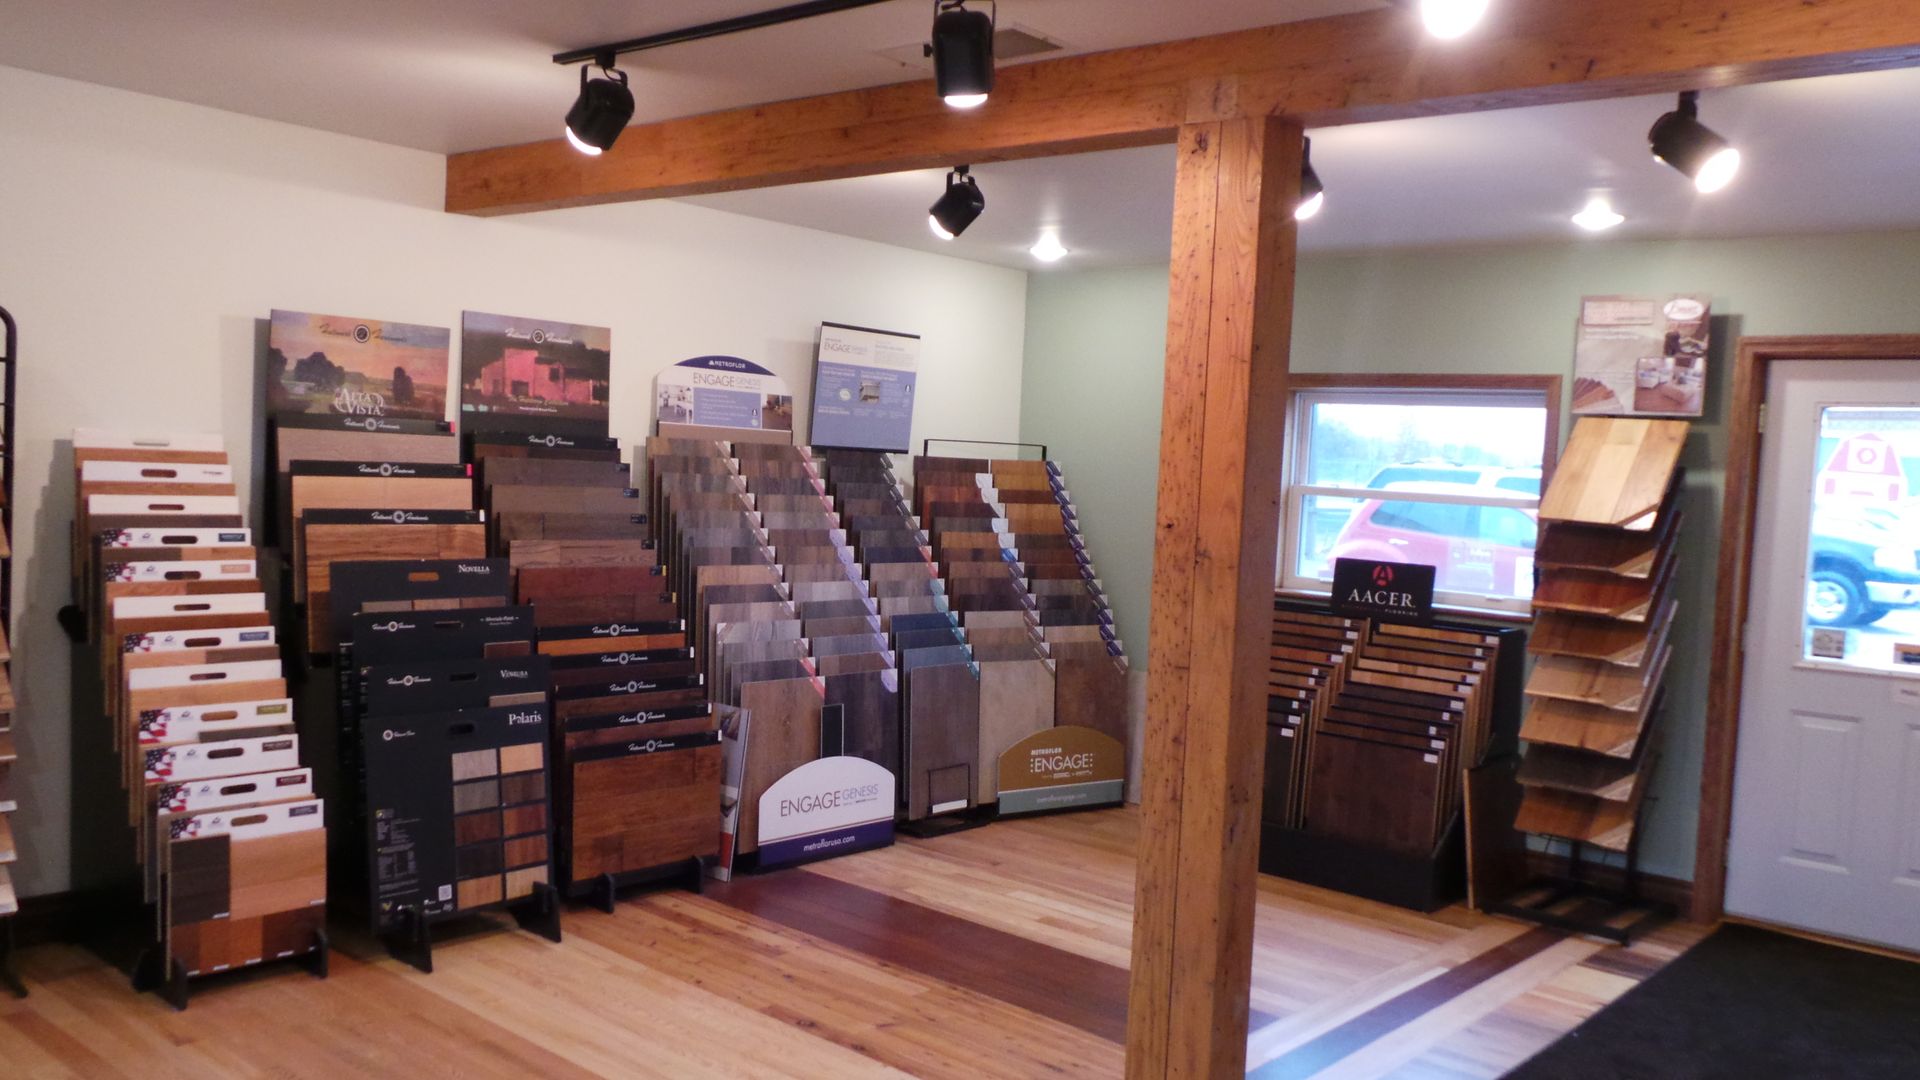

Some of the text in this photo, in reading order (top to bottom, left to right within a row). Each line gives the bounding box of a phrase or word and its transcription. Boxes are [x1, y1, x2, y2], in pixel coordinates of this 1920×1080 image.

[714, 360, 746, 369] METROFLOR
[693, 372, 735, 388] ENGAGE
[346, 399, 382, 415] VISTA
[458, 564, 490, 574] NOVELLA
[1348, 588, 1413, 608] AACER
[508, 710, 542, 725] Polaris
[1034, 753, 1089, 773] ENGAGE
[780, 783, 879, 817] ENGAGE GENESIS
[803, 835, 856, 852] metroflorusa.com
